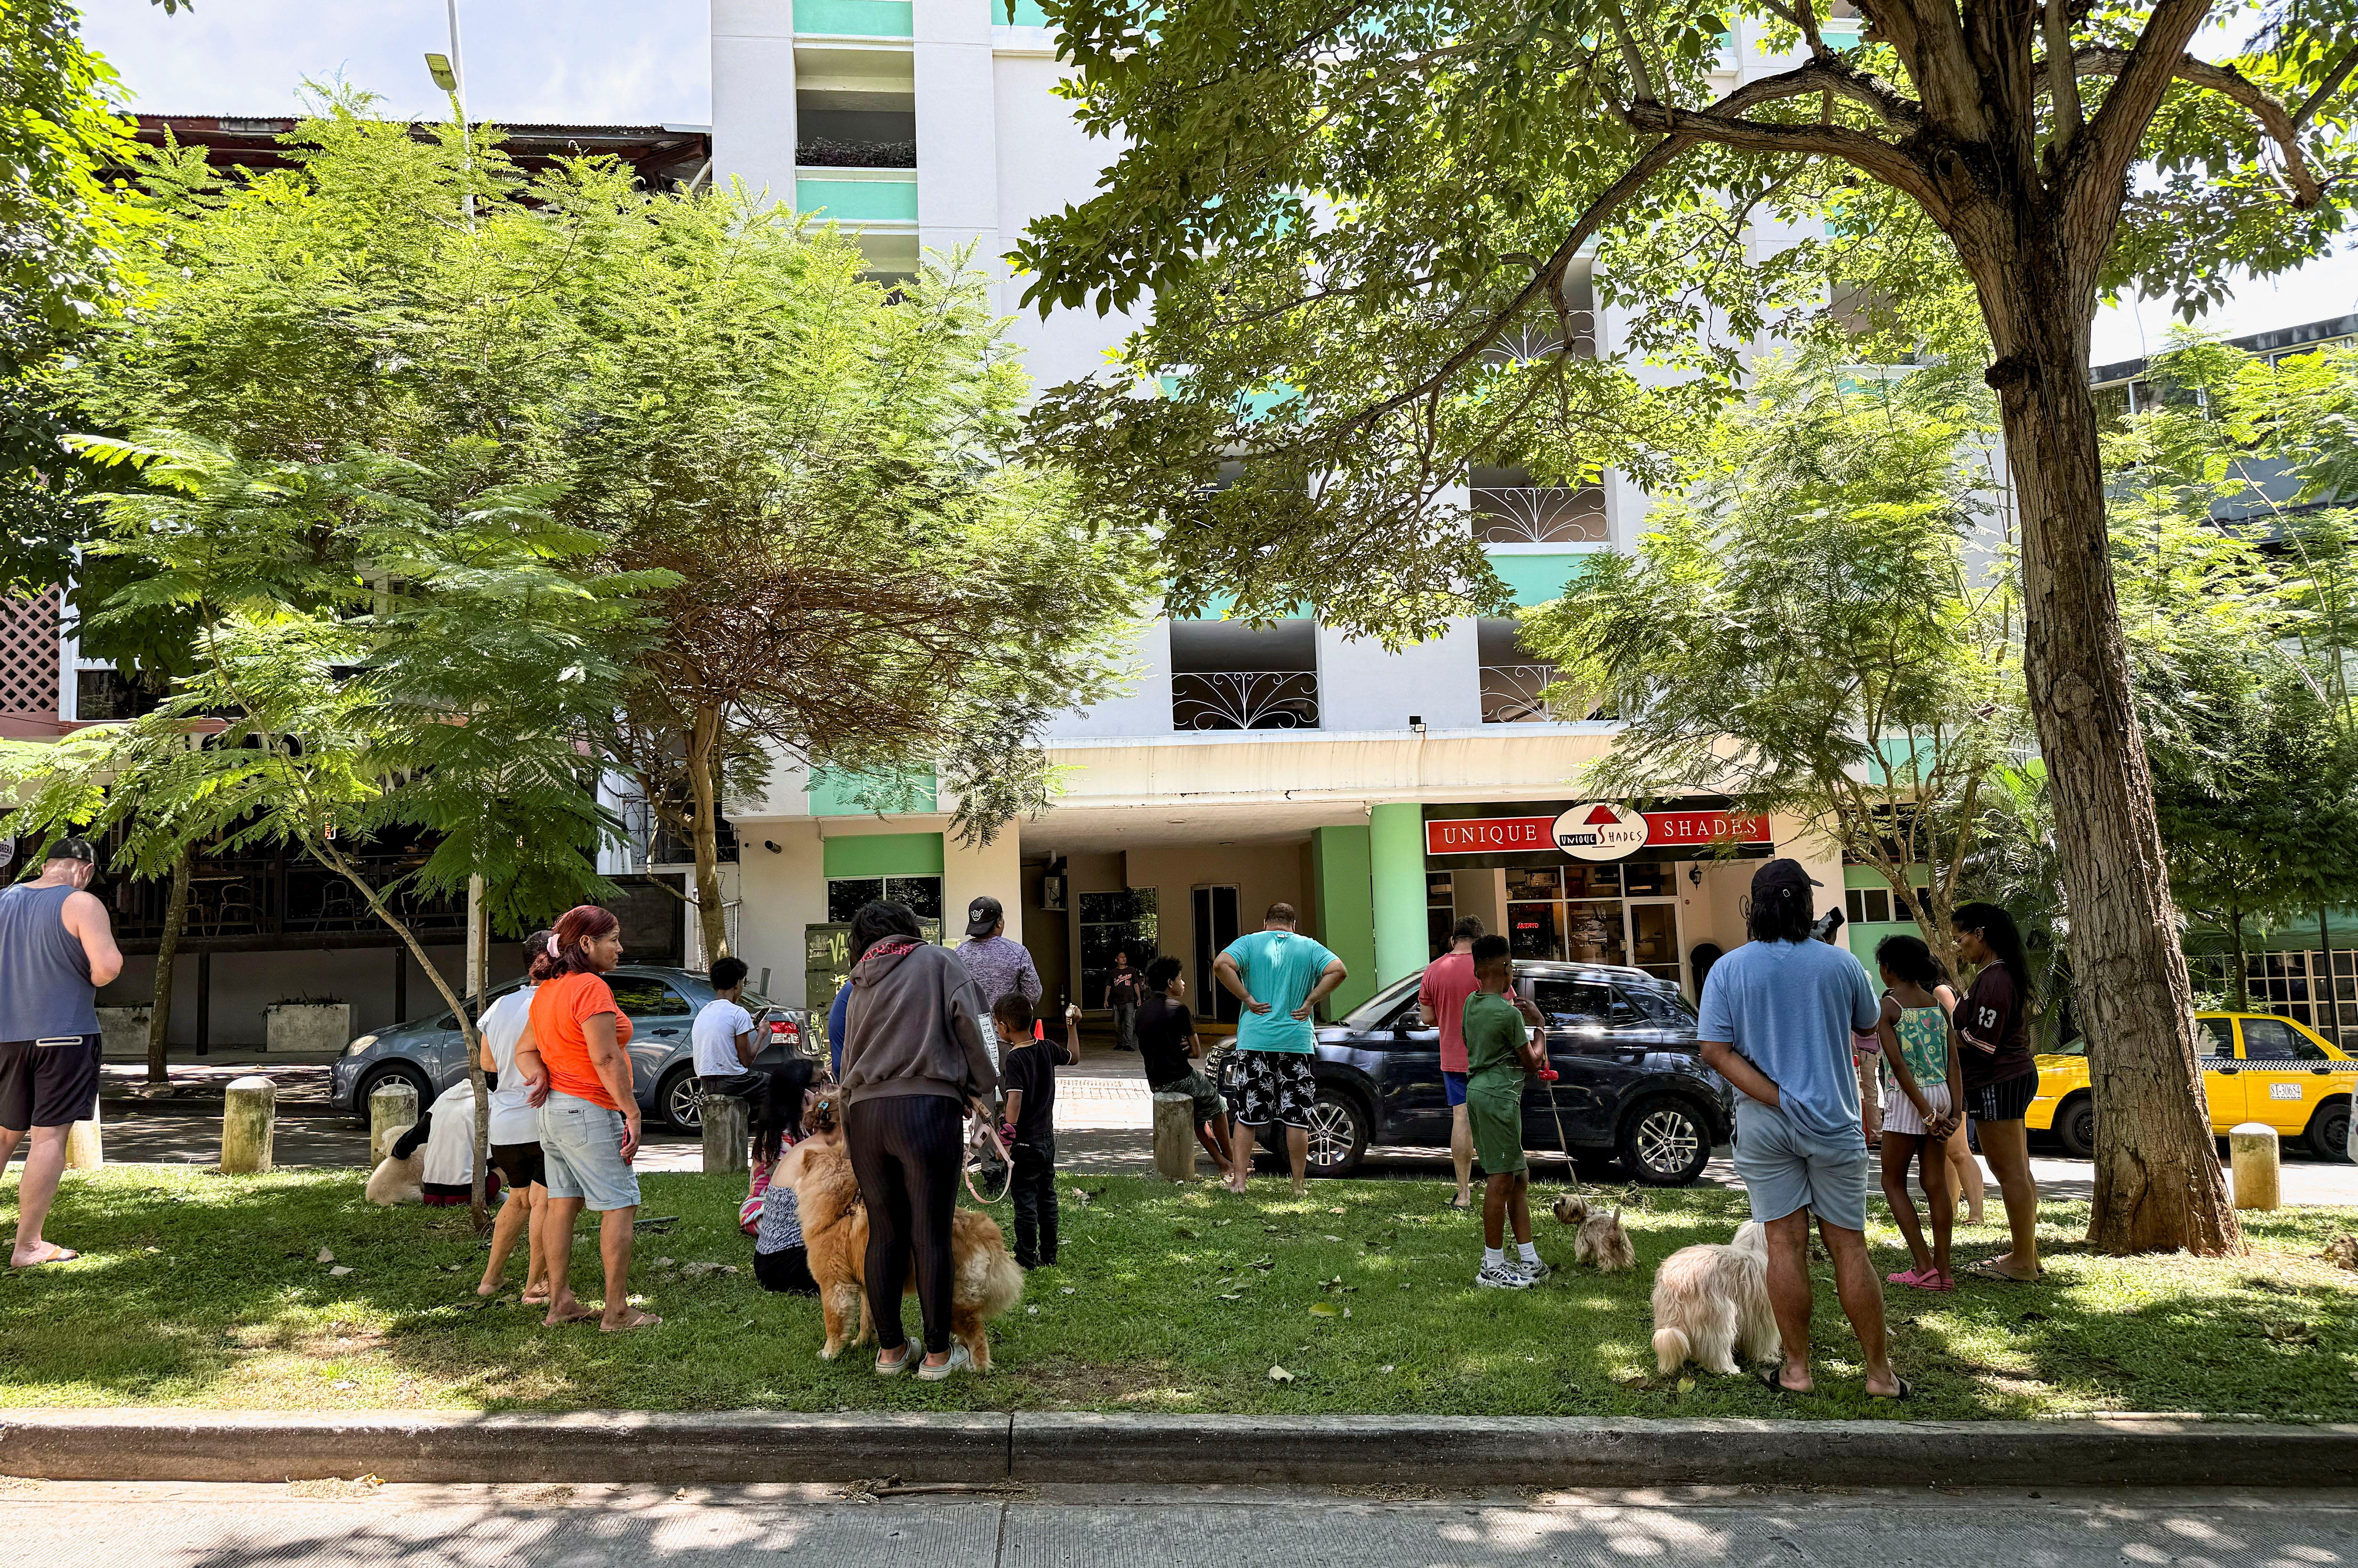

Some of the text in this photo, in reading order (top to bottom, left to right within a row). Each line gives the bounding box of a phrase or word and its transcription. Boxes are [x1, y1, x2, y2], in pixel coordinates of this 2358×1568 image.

[1443, 819, 1759, 845] UNIQUE SHADES
[1561, 824, 1643, 846] UNIQUE SHADES
[1978, 1006, 1997, 1029] 23
